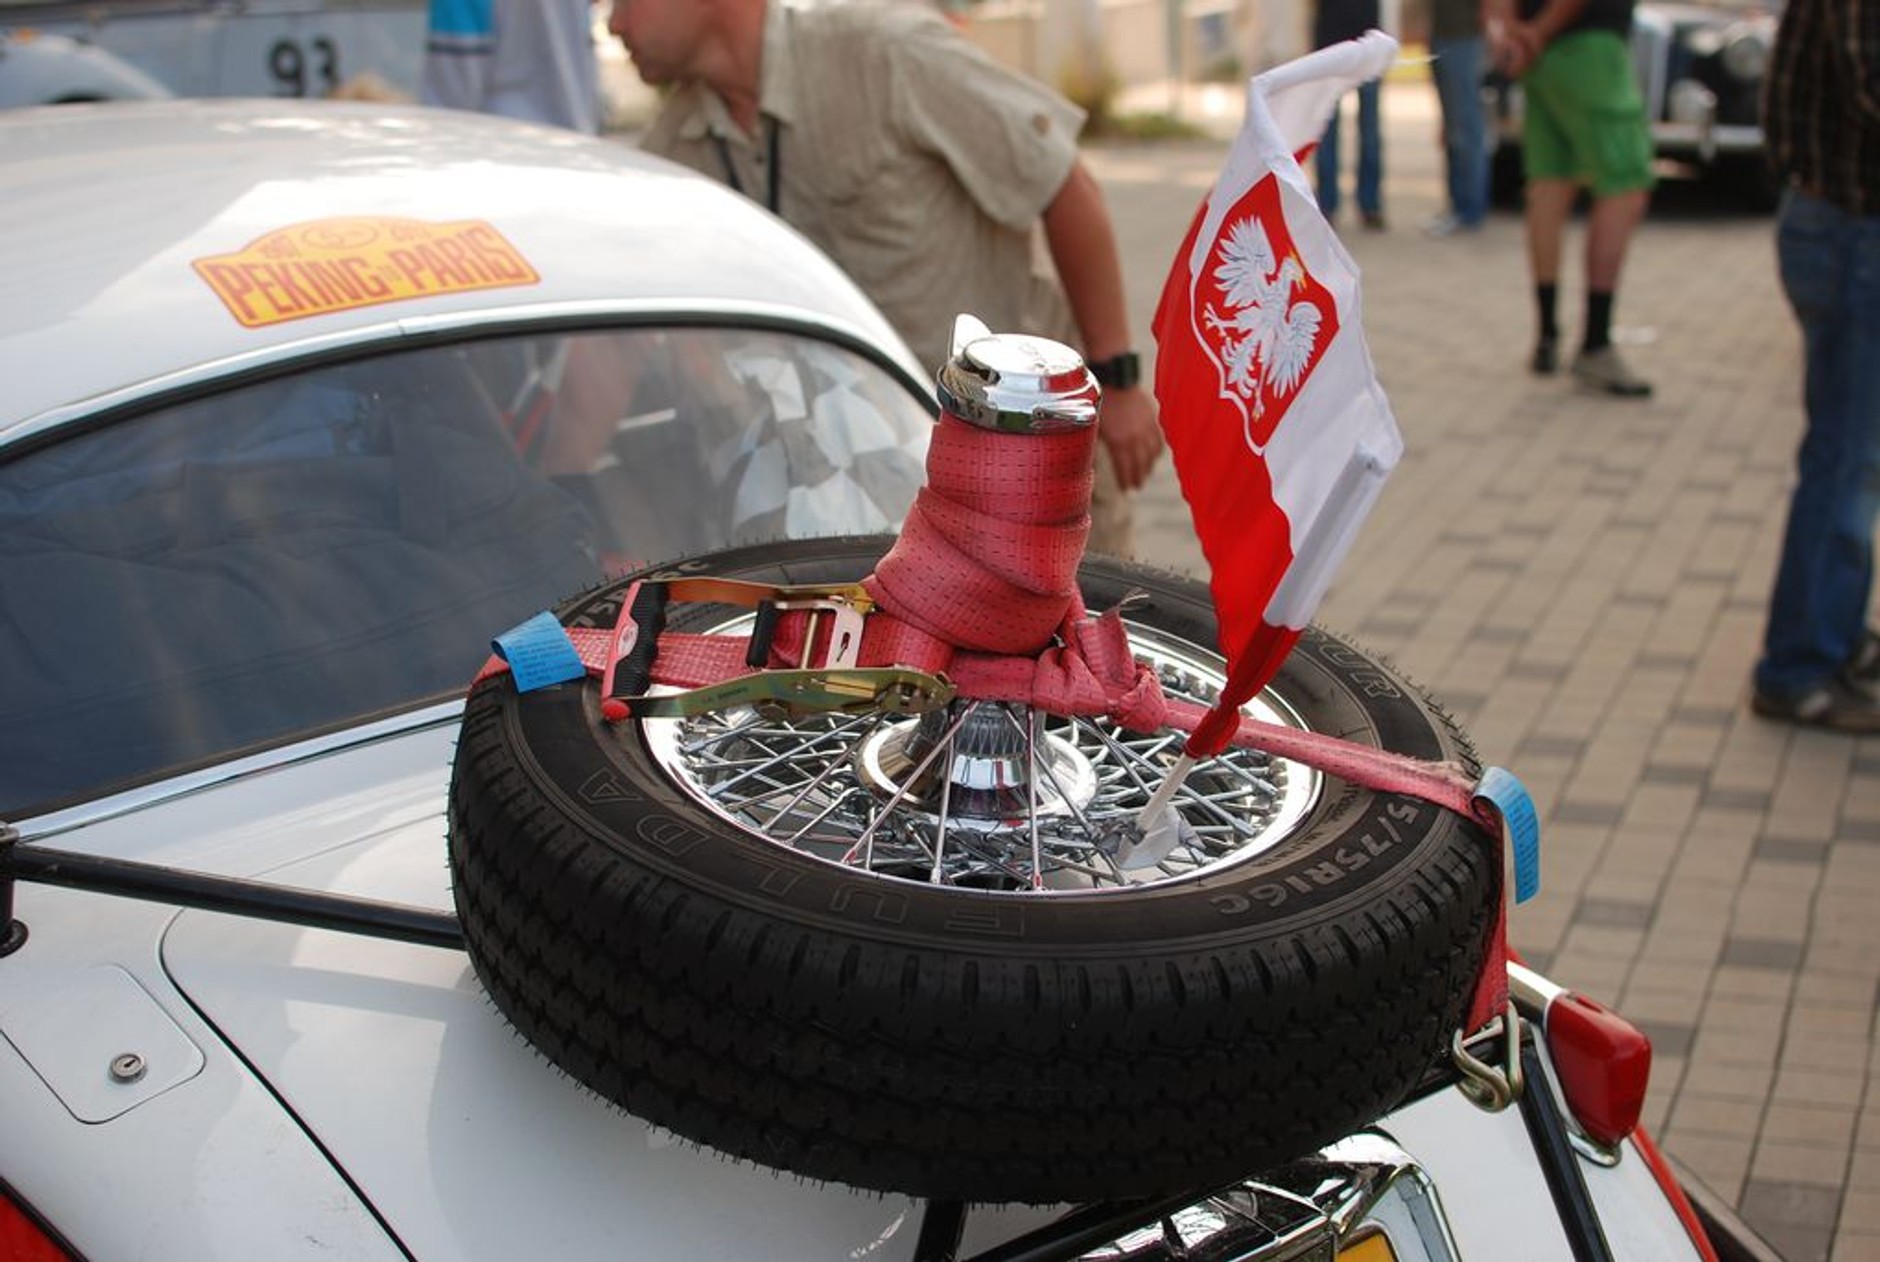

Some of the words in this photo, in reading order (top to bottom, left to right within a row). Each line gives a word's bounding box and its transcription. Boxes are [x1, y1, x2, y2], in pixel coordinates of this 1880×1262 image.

[267, 38, 339, 97] 93
[207, 255, 394, 320] PEKING
[387, 227, 522, 291] PARIS
[576, 766, 1026, 937] FULDA
[1209, 797, 1420, 915] 5/75R16C
